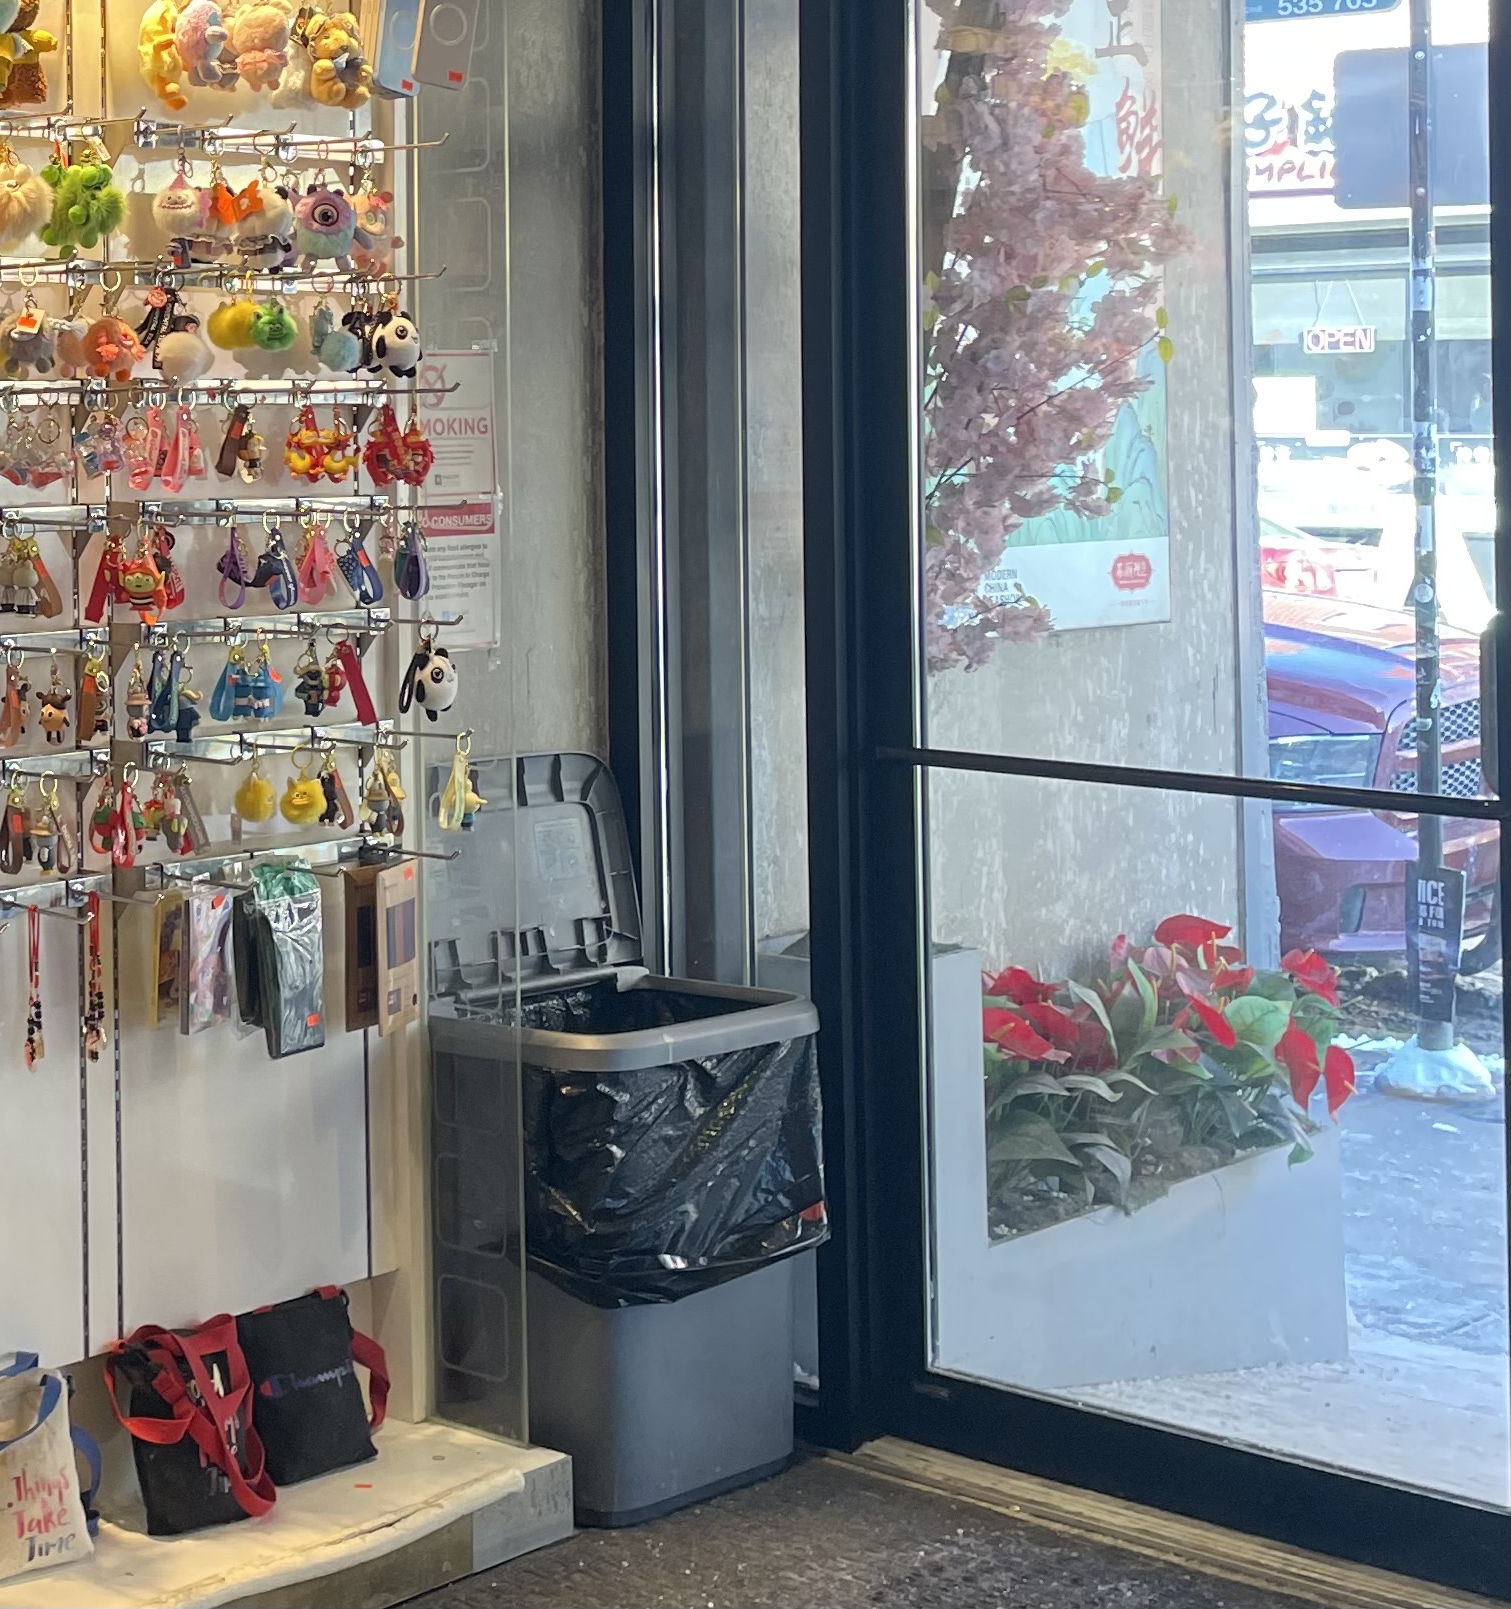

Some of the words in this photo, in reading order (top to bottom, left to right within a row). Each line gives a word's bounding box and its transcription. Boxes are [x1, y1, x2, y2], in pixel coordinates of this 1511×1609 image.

[1306, 328, 1373, 350] OPEN
[421, 417, 488, 437] MOKING
[432, 514, 493, 526] CONSUMERS
[12, 1467, 69, 1506] Things
[13, 1498, 70, 1539] Take
